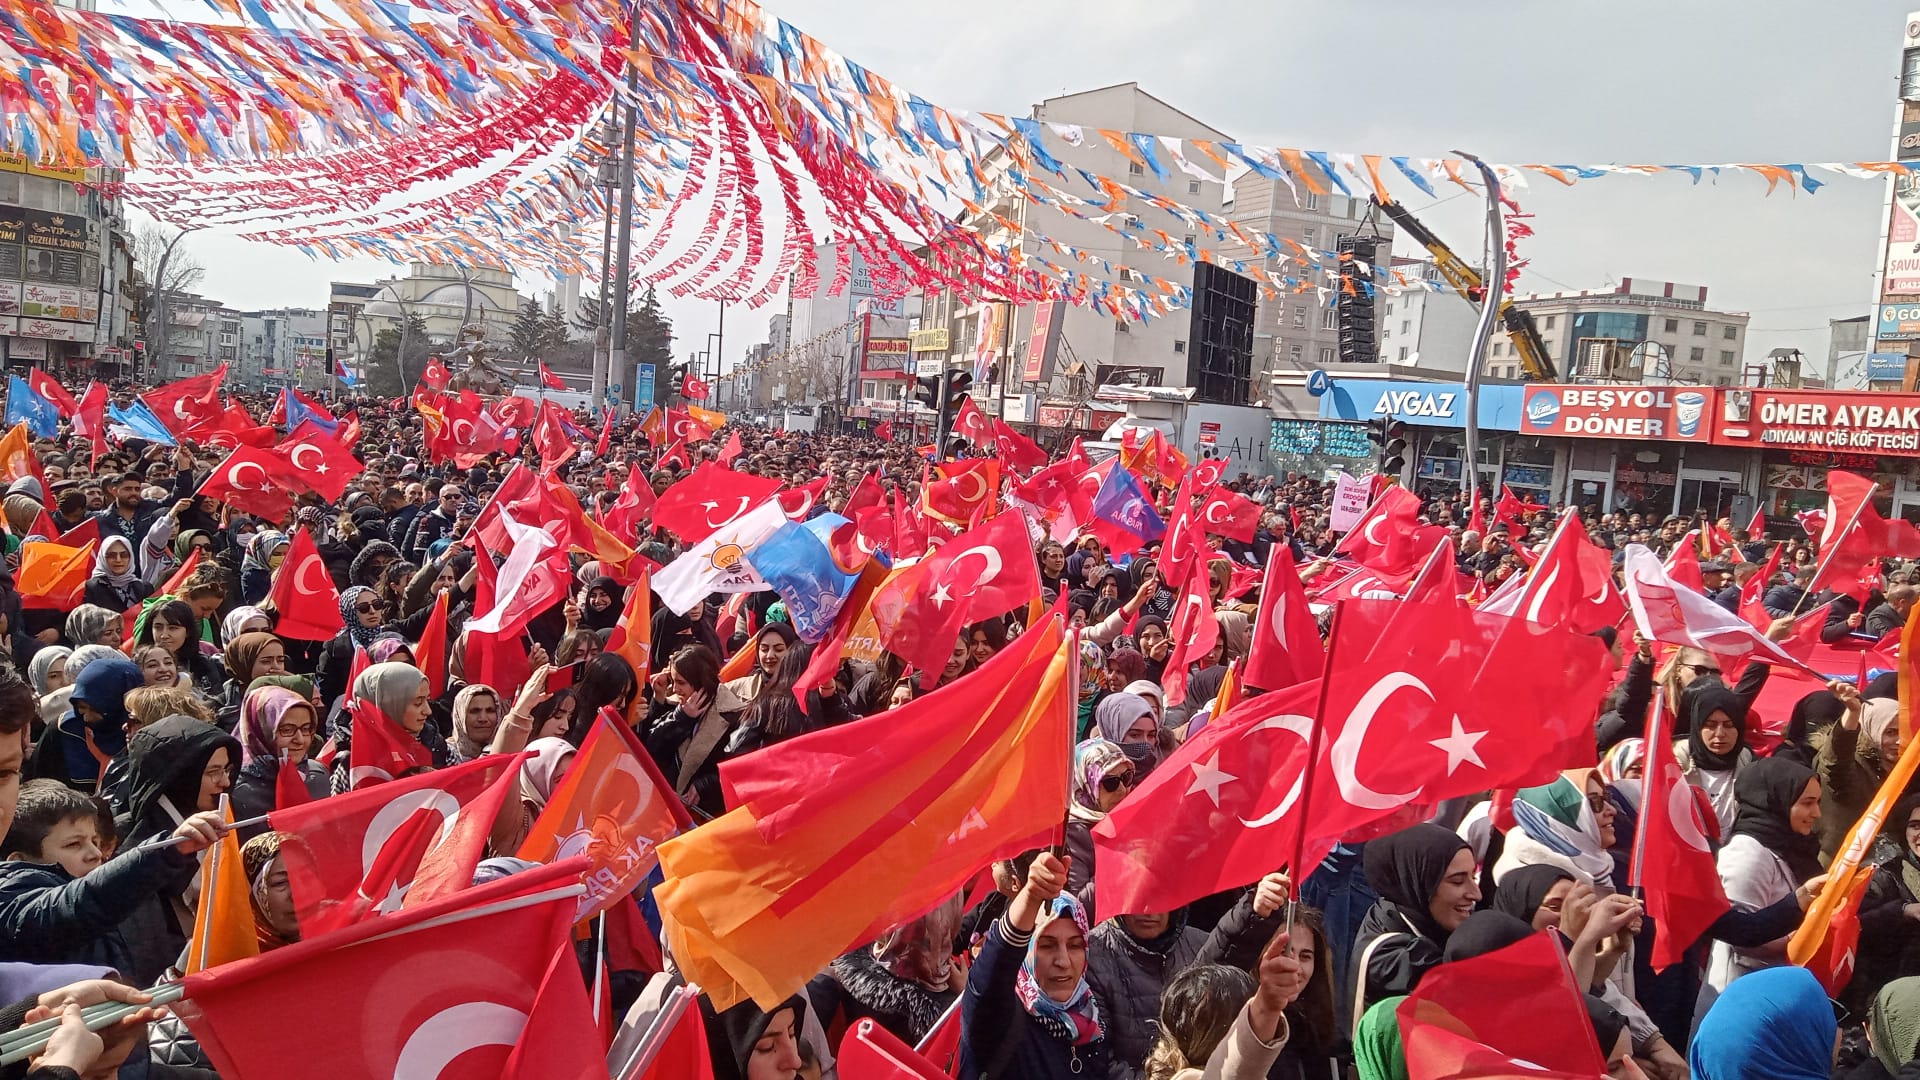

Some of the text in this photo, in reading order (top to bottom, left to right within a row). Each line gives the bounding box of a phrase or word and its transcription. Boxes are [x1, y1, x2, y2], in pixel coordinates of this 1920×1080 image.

[1374, 390, 1457, 418] AYGAZ
[1562, 389, 1673, 412] BEŞYOL
[1564, 413, 1663, 436] DÖNER
[1761, 397, 1920, 430] ÖMER AYBAK
[1826, 429, 1849, 448] ÇİĞ
[1850, 431, 1919, 450] KÖFTECİSİ
